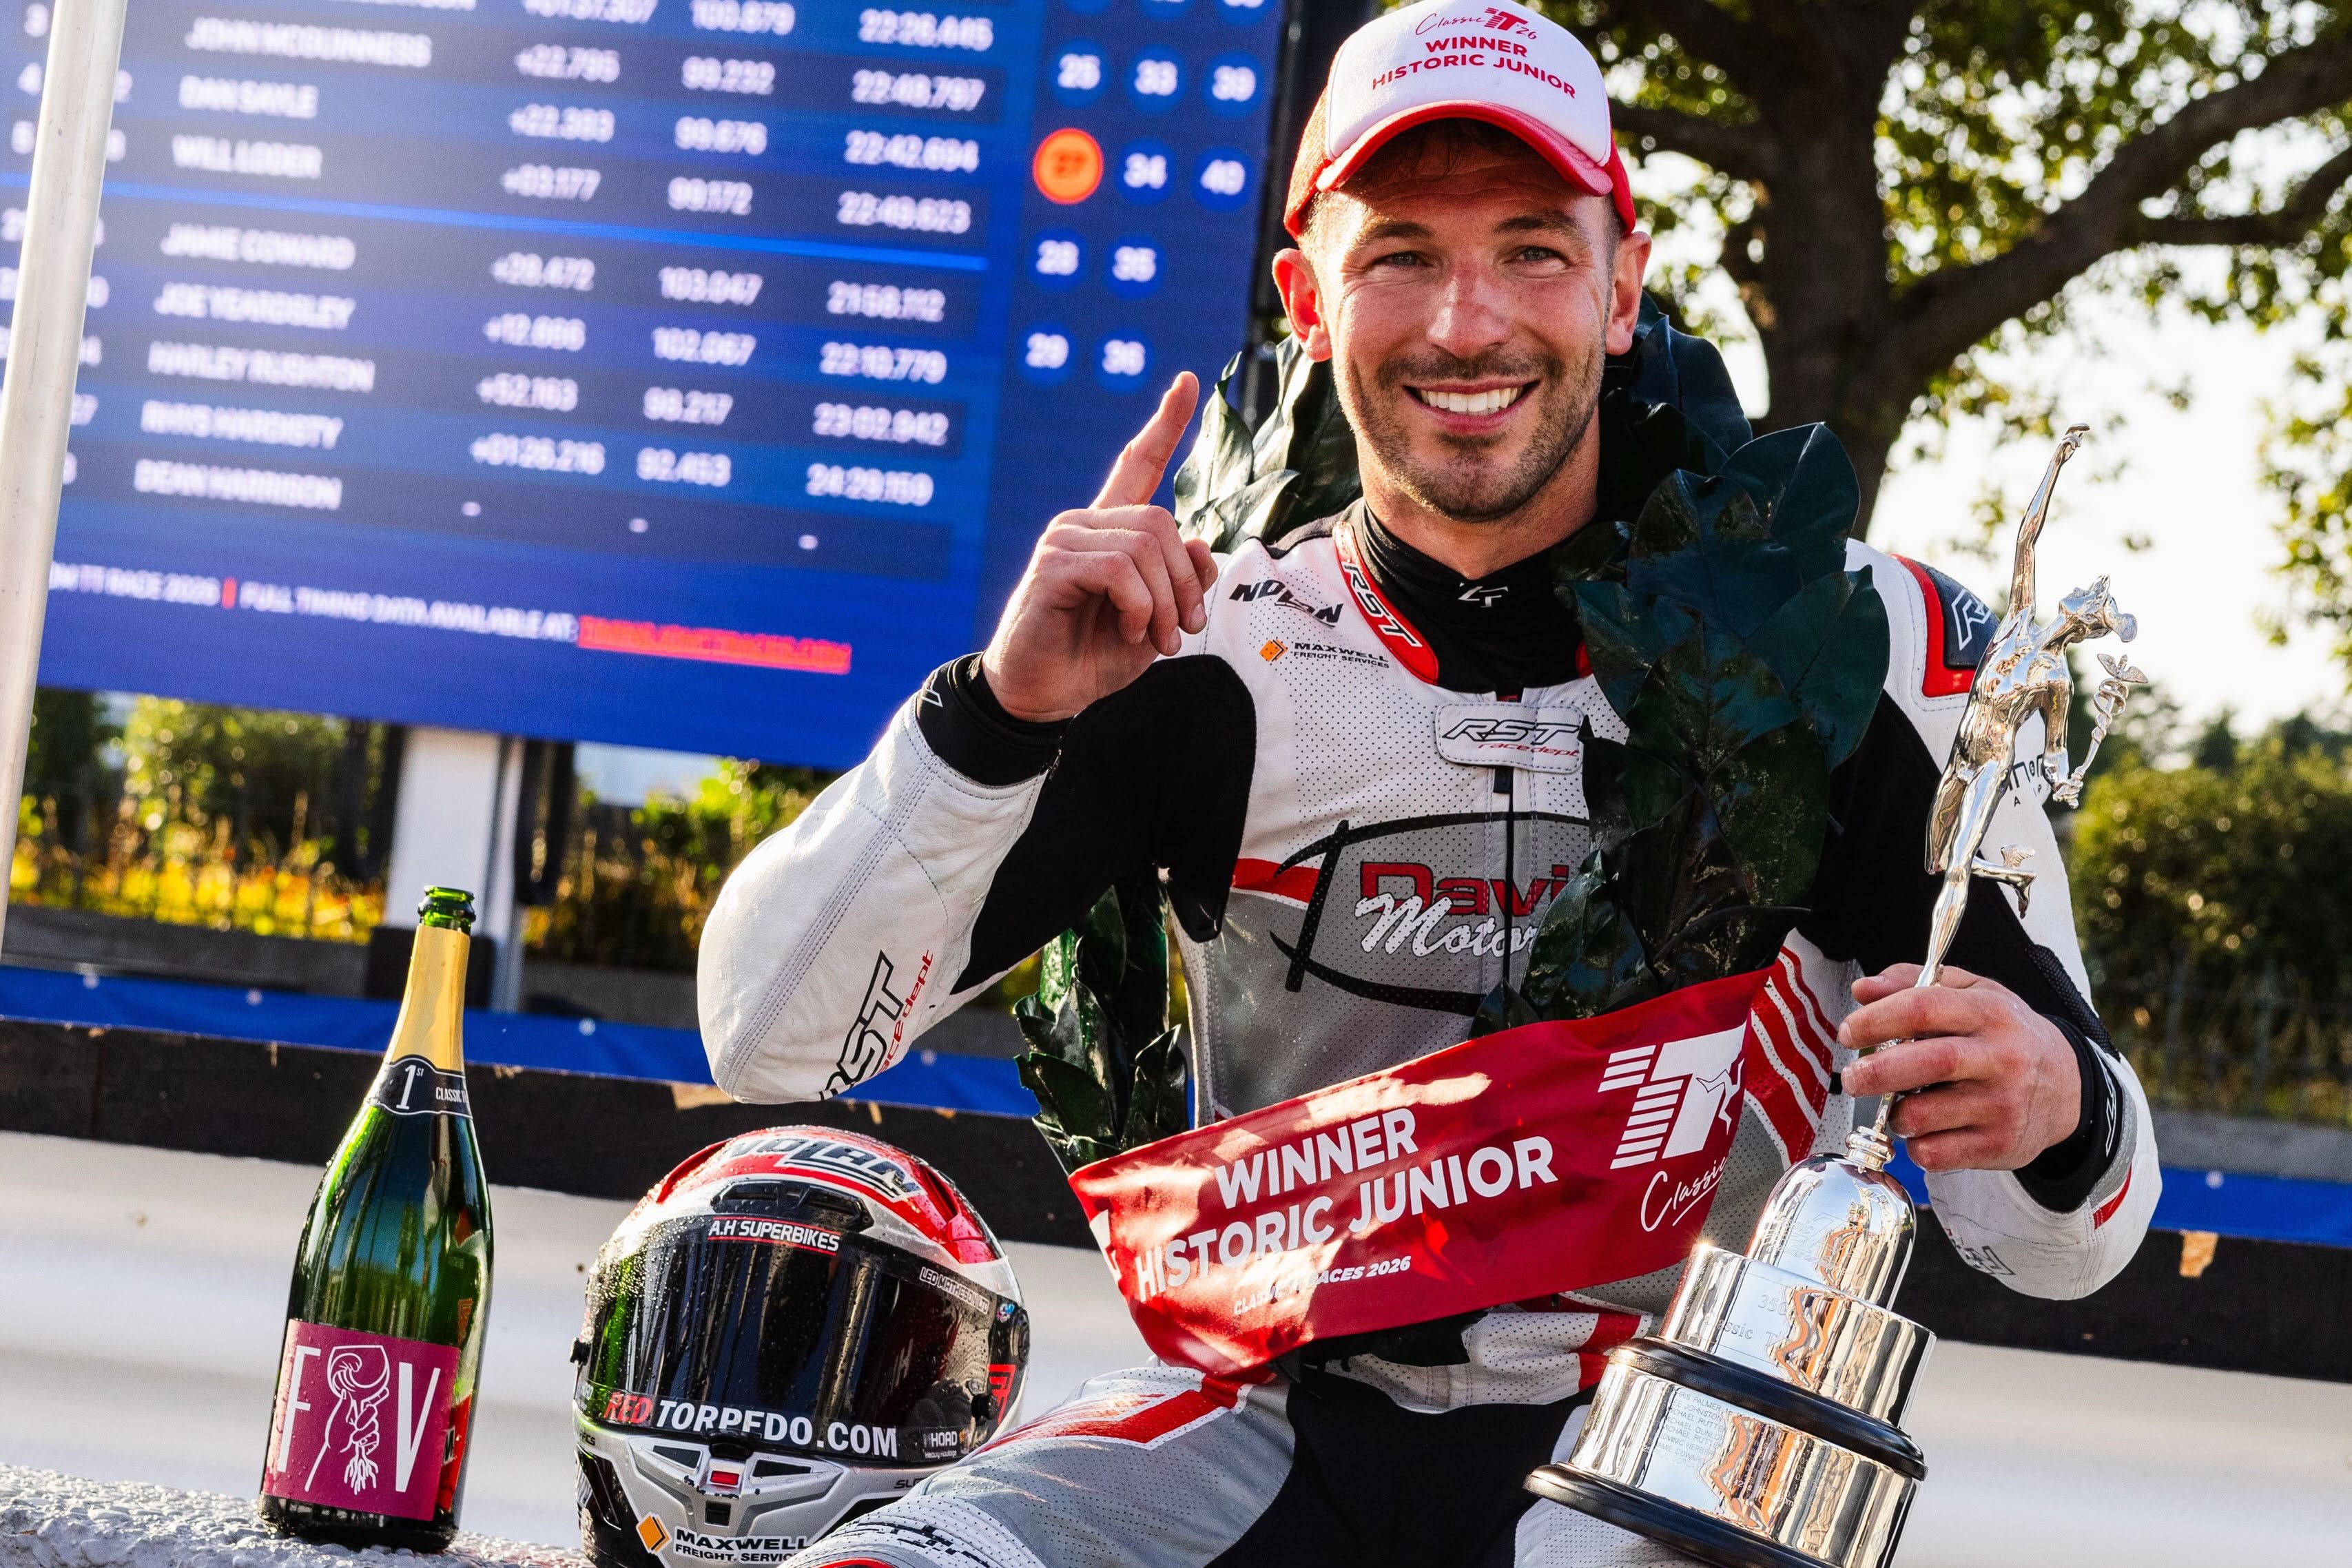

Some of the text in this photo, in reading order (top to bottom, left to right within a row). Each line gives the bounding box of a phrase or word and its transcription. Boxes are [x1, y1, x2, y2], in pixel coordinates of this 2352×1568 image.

[185, 17, 262, 54] JOHN
[1415, 12, 1486, 36] Classic
[1425, 36, 1528, 58] WINNER
[1372, 53, 1576, 100] HISTORIC JUNIOR
[238, 79, 319, 118] SAYLE
[172, 134, 232, 172] WILL
[134, 458, 208, 497] DEAN
[104, 566, 165, 601] RACE
[239, 581, 296, 613] FULL
[371, 594, 429, 626] DATA
[427, 599, 543, 641] AVAILABLE
[1342, 561, 1423, 648] RST
[1293, 650, 1390, 669] FREIGHT SERVICES
[1294, 642, 1389, 663] MAXWELL
[1441, 718, 1580, 745] RST
[435, 1086, 462, 1103] CLASSIC
[727, 1136, 922, 1197] NOLAN
[1215, 1107, 1419, 1210] WINNER
[708, 1219, 840, 1252] A.H SUPERBIKES
[1136, 1194, 1334, 1303] HISTORIC
[1347, 1134, 1558, 1241] JUNIOR
[1365, 1255, 1412, 1278] 2026
[919, 1266, 990, 1314] LEO MATHESON LTD
[1684, 1405, 1722, 1423] JOHNSTON
[1693, 1396, 1722, 1411] PALMER
[603, 1390, 654, 1425] RED
[656, 1399, 898, 1458] TORPEDO.COM
[930, 1430, 958, 1447] HOAD
[676, 1528, 815, 1551] MAXWELL
